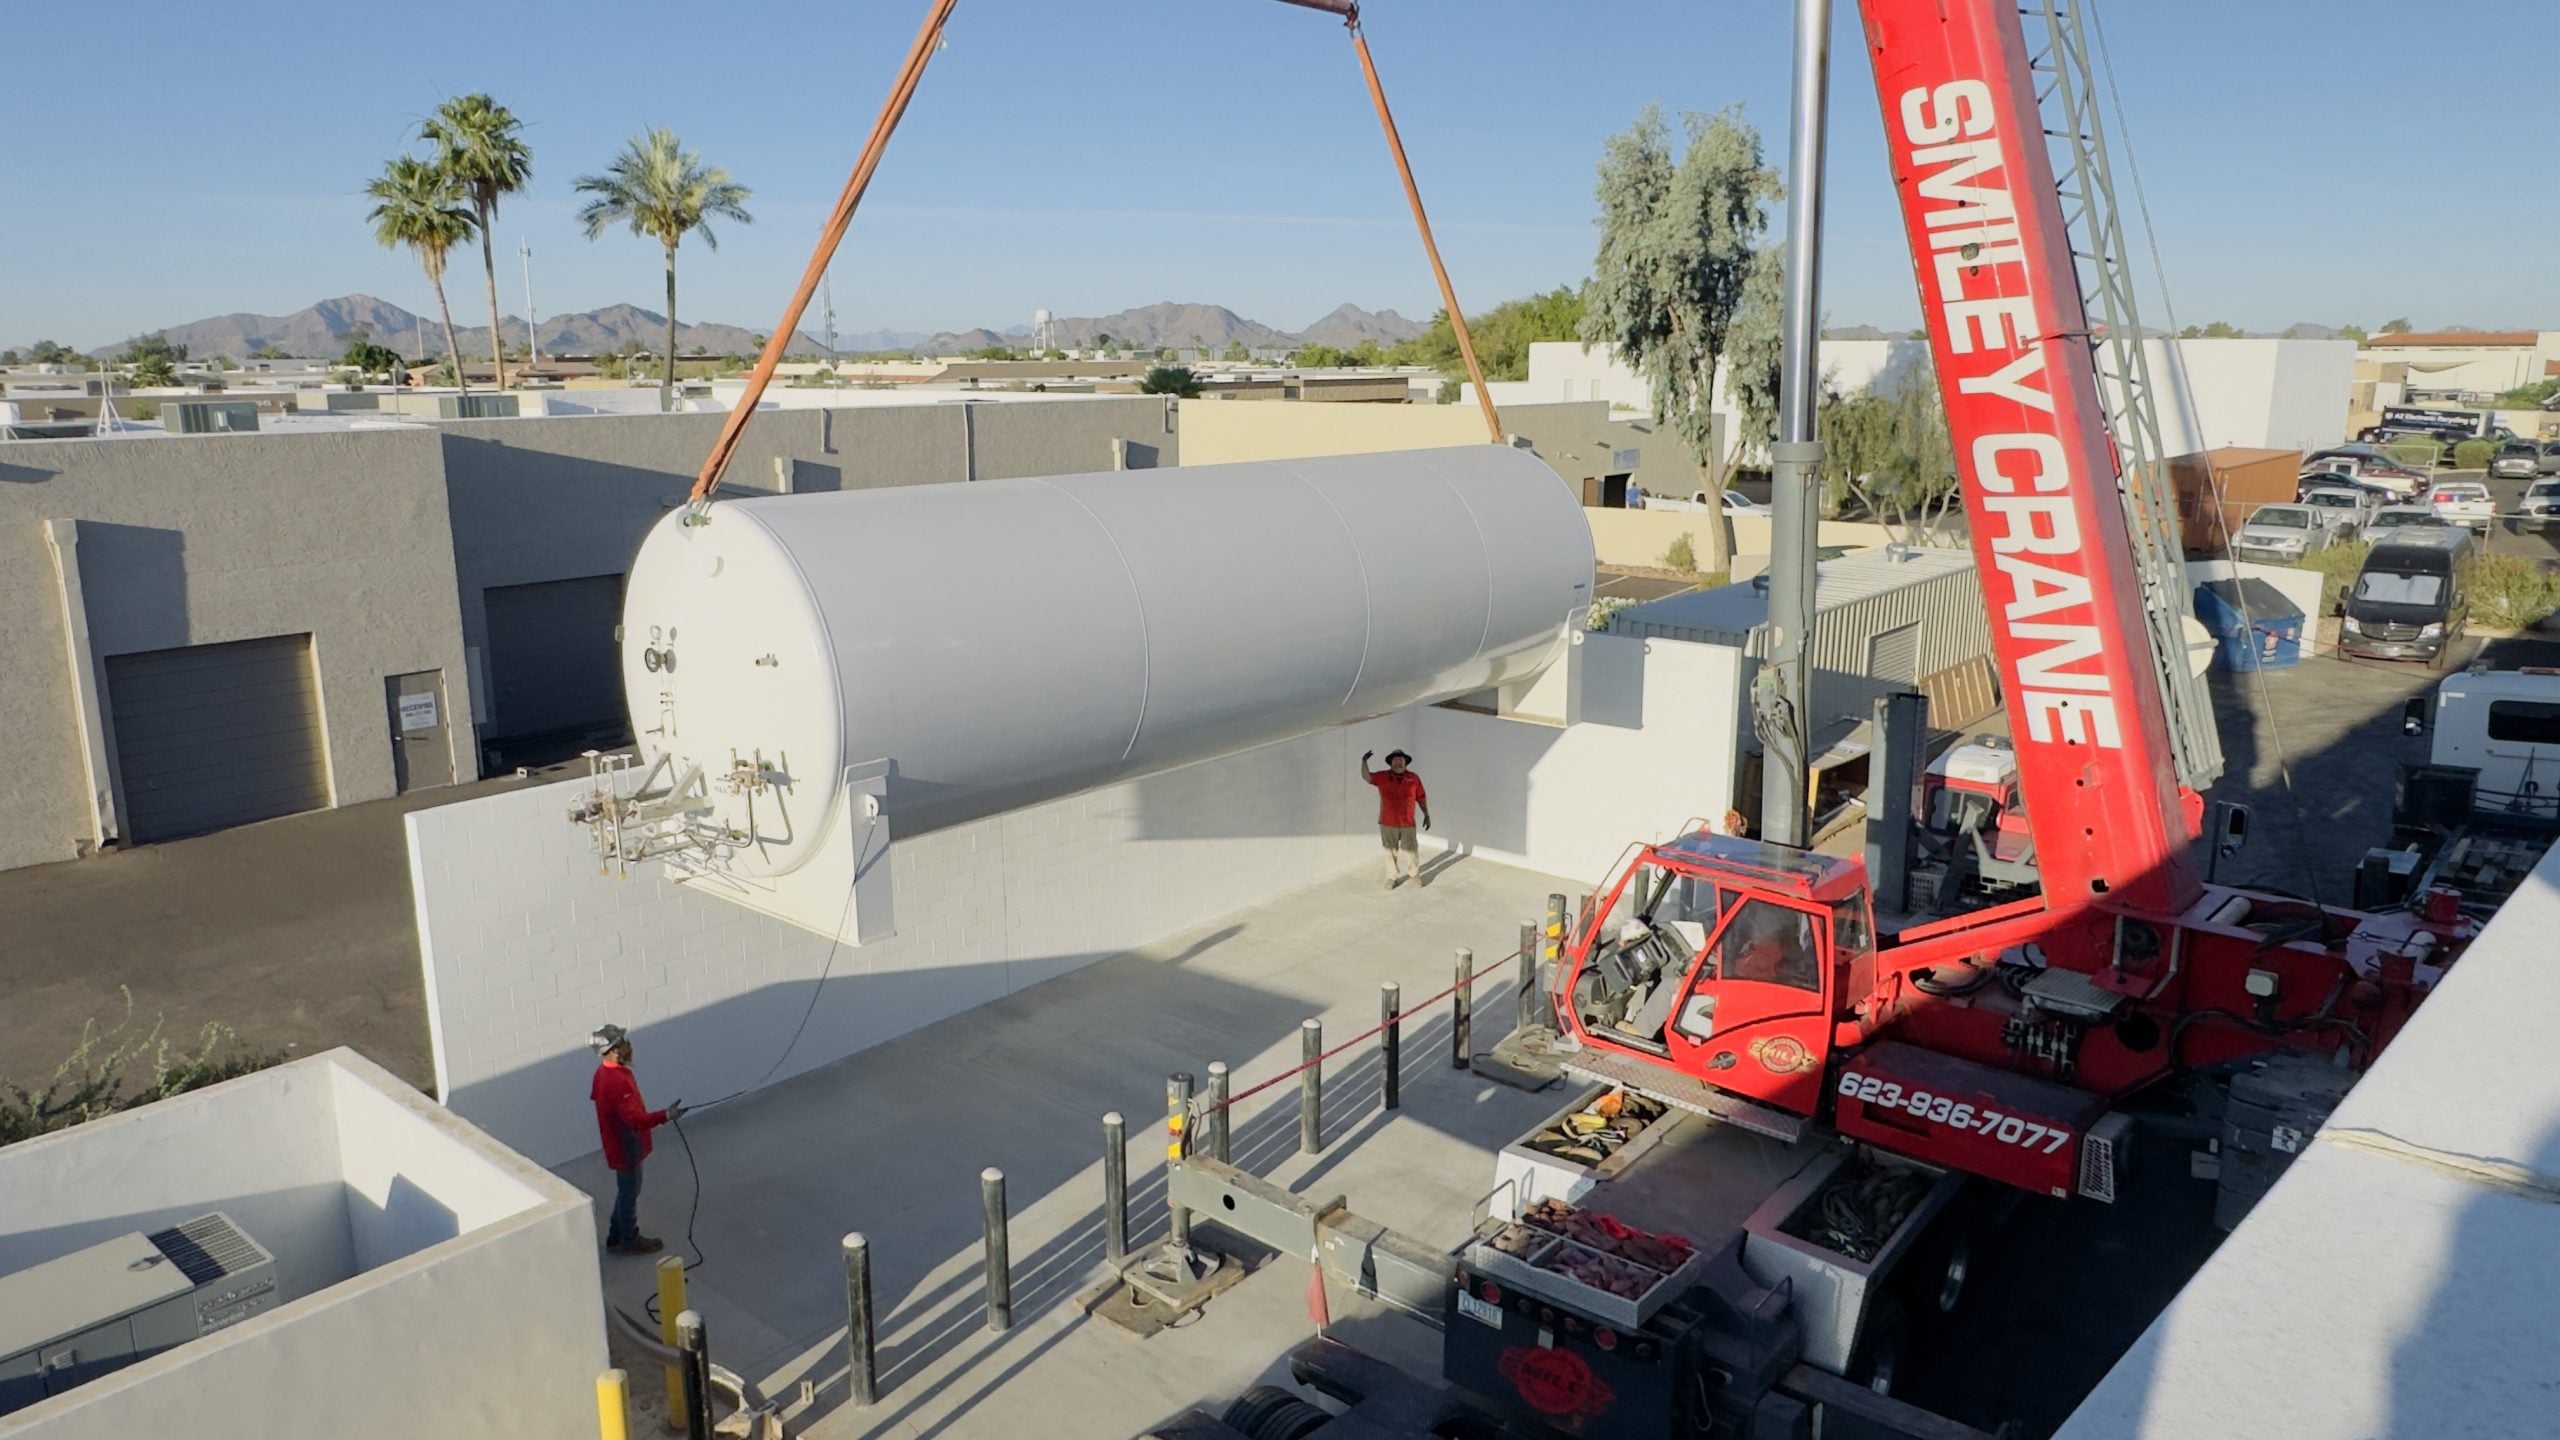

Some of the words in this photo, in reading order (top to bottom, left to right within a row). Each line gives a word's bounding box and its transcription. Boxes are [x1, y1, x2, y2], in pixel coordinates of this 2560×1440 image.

[1900, 79, 2055, 414] SMILEY
[1971, 433, 2122, 749] CRANE
[1838, 1072, 2070, 1154] 623-936-7077
